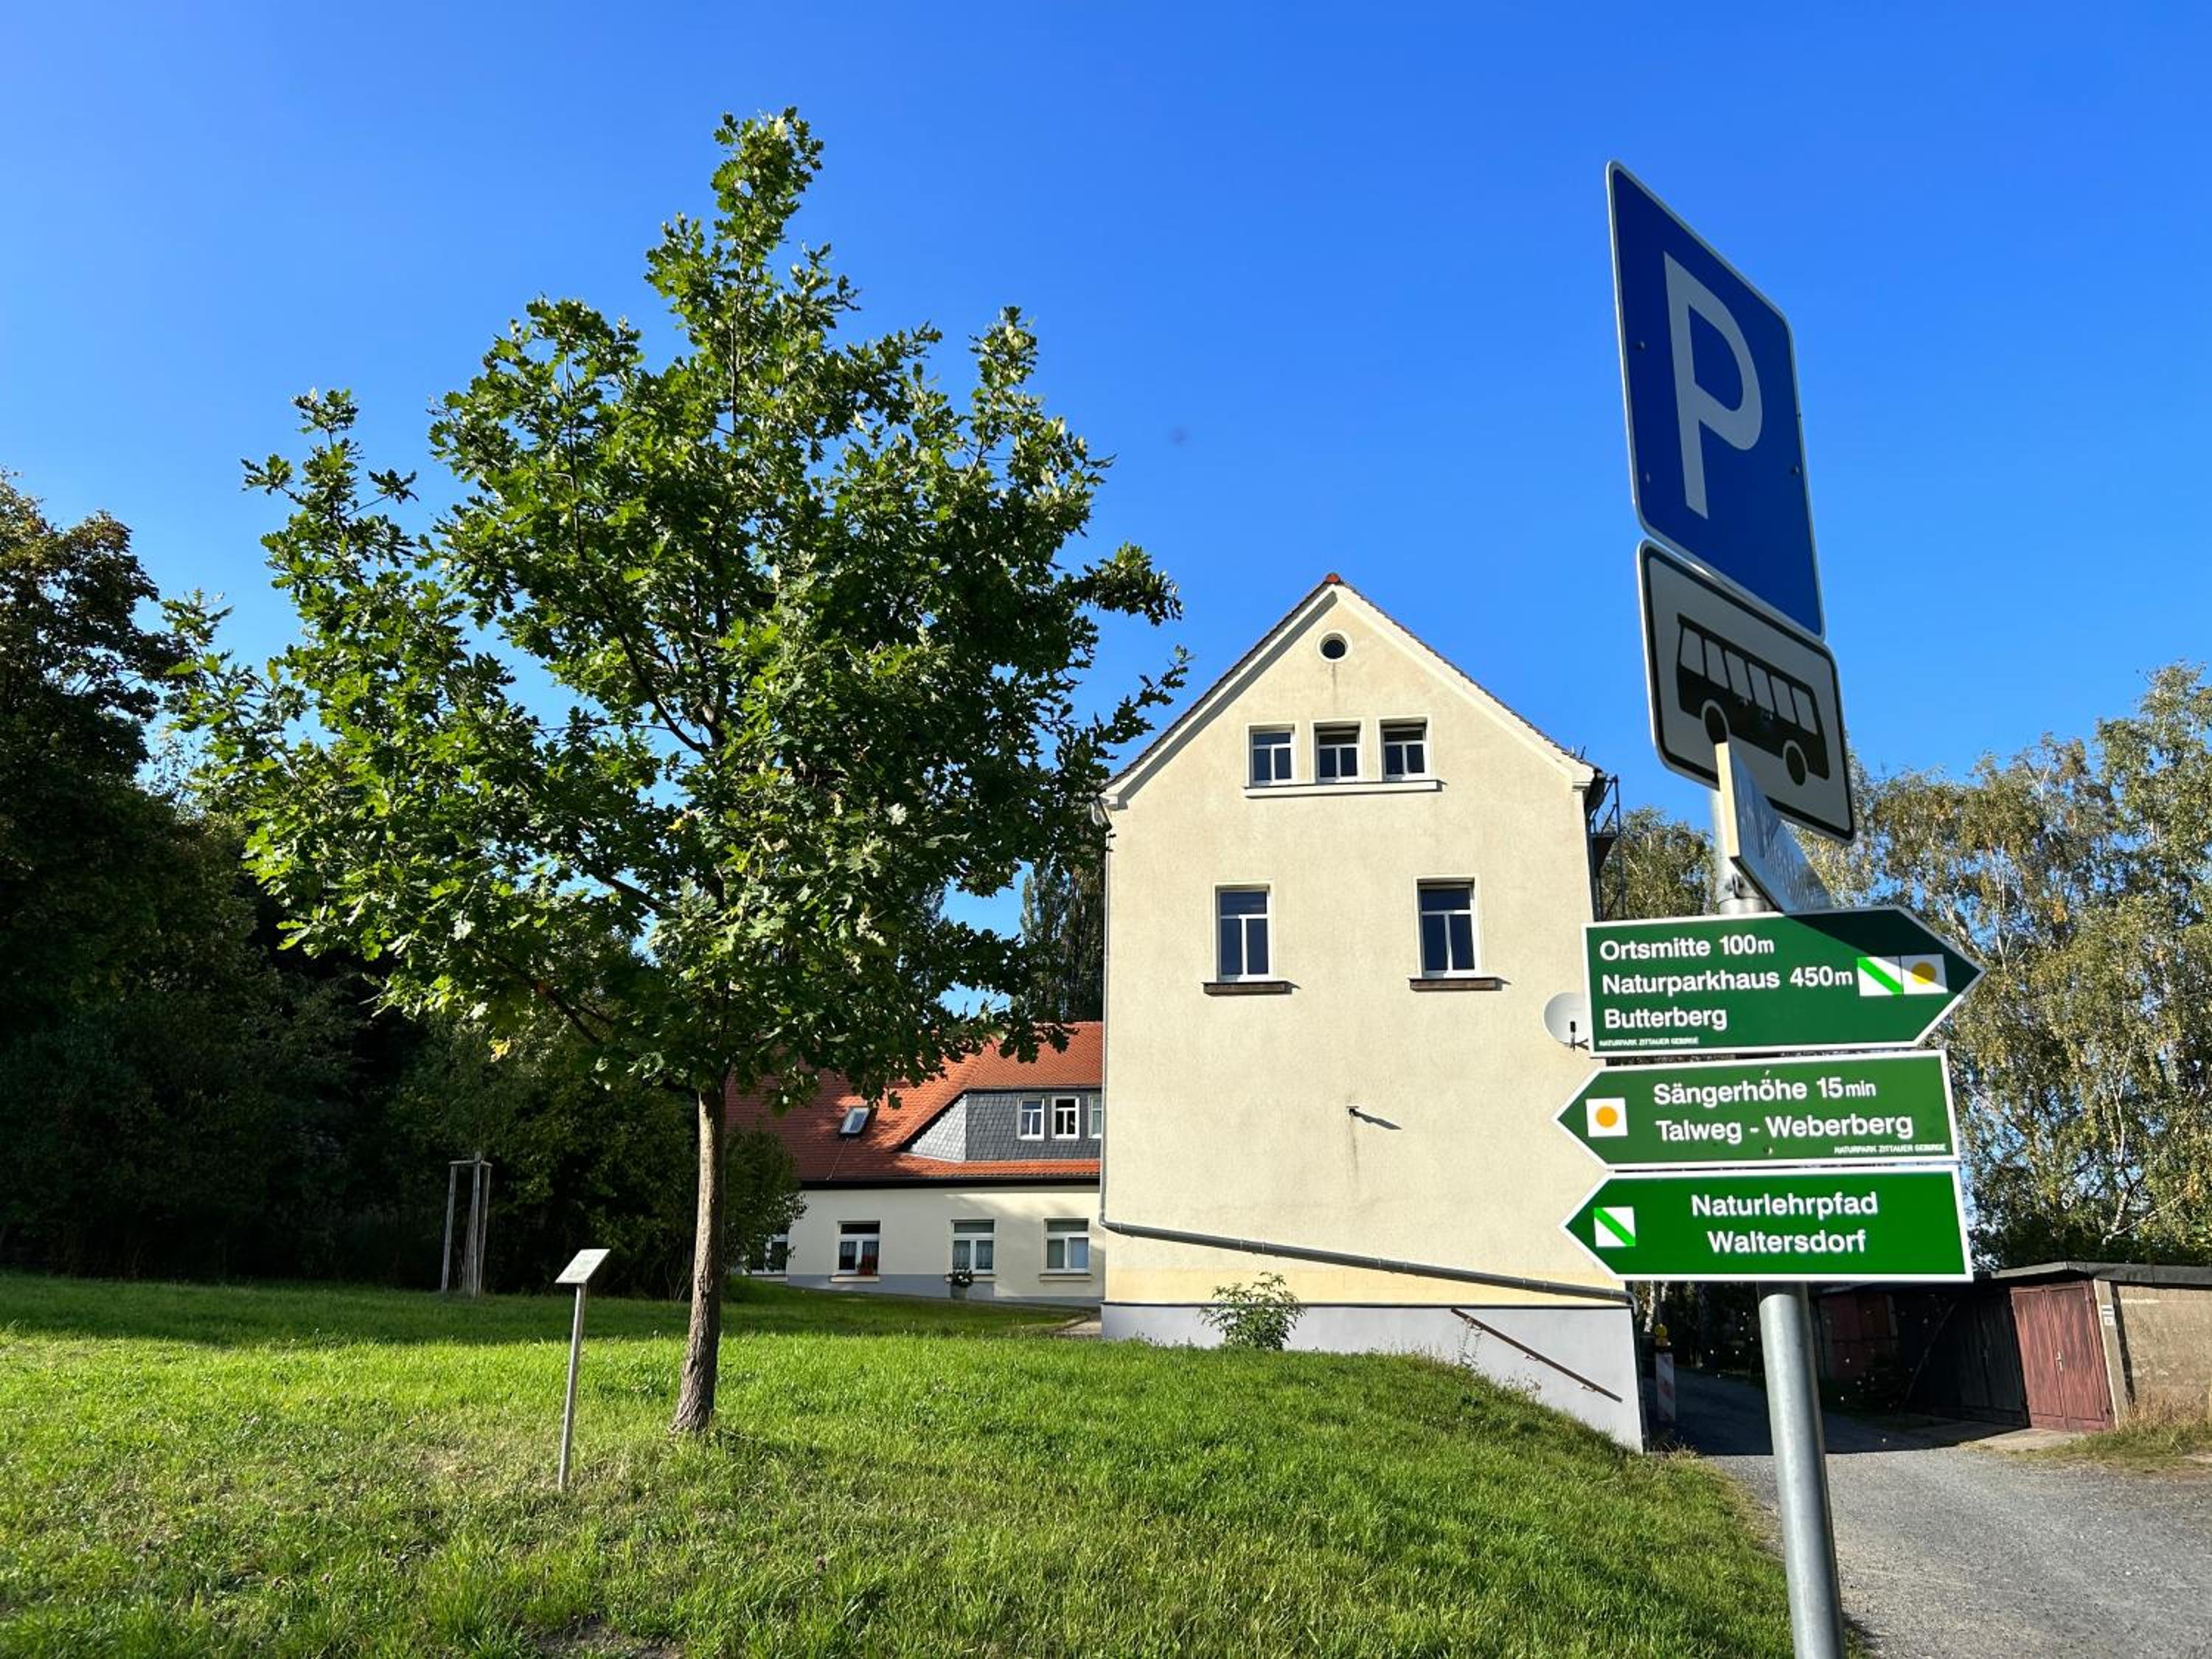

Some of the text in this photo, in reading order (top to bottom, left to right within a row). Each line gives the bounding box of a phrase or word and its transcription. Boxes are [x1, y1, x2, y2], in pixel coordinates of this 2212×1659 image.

[1663, 251, 1762, 519] P
[1599, 934, 1775, 961] Ortsmitte 100m
[1602, 966, 1853, 997] Naturparkhaus 450m
[1604, 1007, 1728, 1031] Butterberg
[1653, 1079, 1807, 1108] Sängerhöhe
[1655, 1119, 1742, 1145] Talweg
[1765, 1113, 1914, 1140] Weberberg
[1691, 1191, 1879, 1221] Naturlehrpfad
[1707, 1229, 1866, 1253] Waltersdorf
